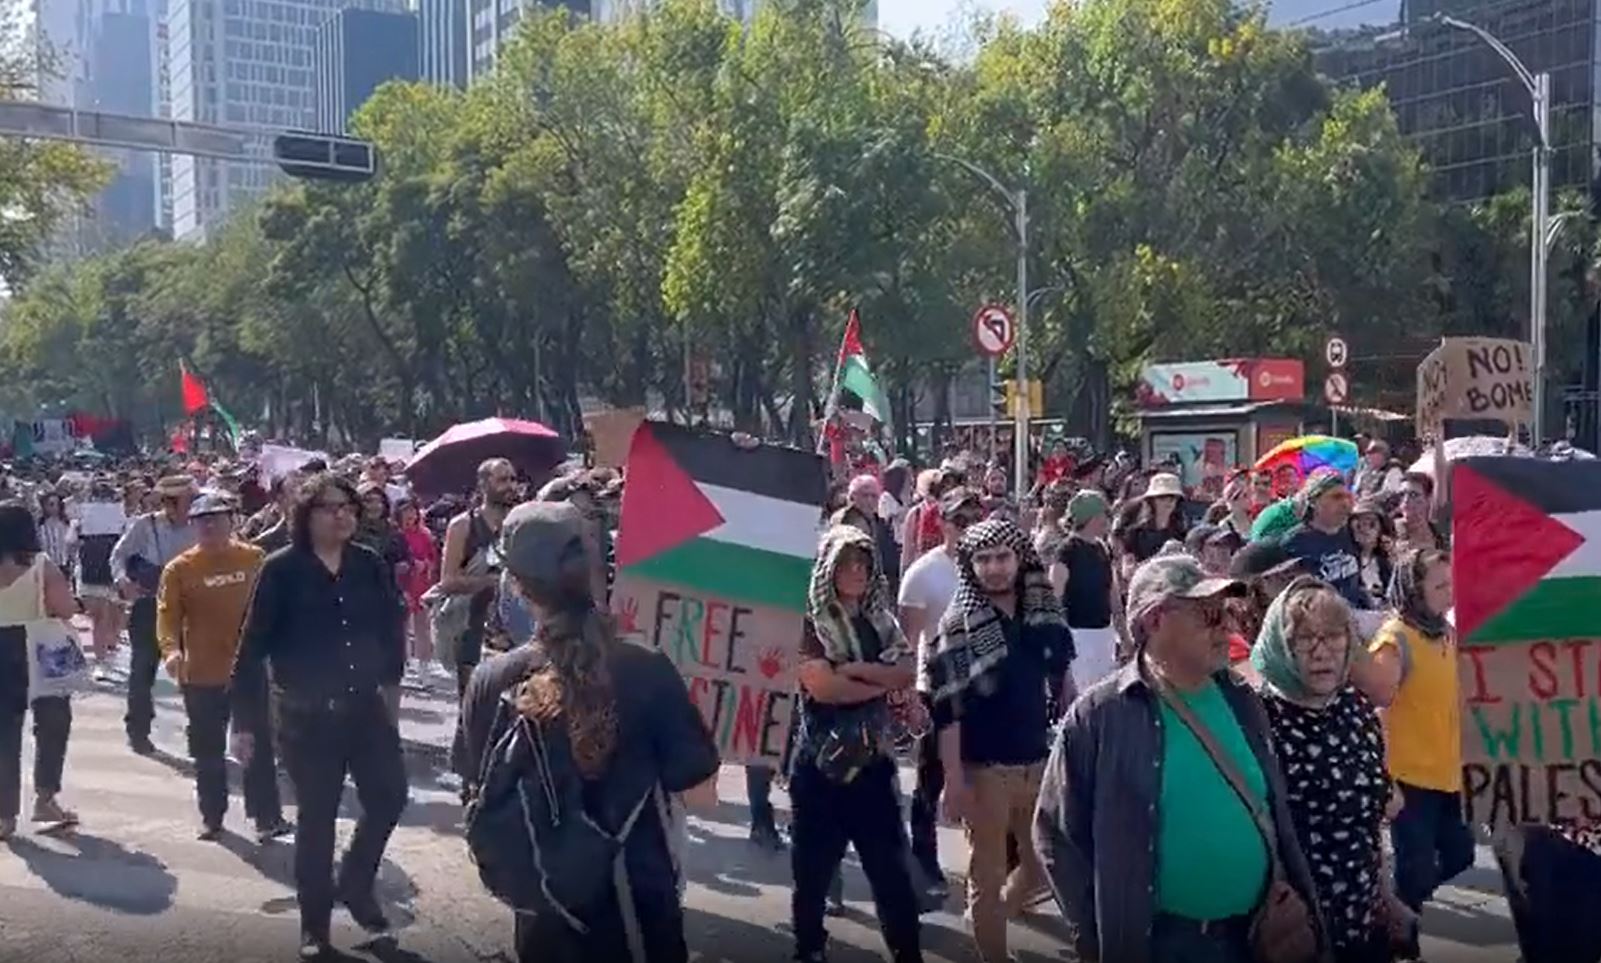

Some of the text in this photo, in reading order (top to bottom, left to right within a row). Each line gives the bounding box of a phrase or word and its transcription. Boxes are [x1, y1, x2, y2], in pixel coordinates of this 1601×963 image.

[1466, 345, 1523, 378] NO!
[654, 590, 753, 674] FREE
[1459, 639, 1601, 703] I ST
